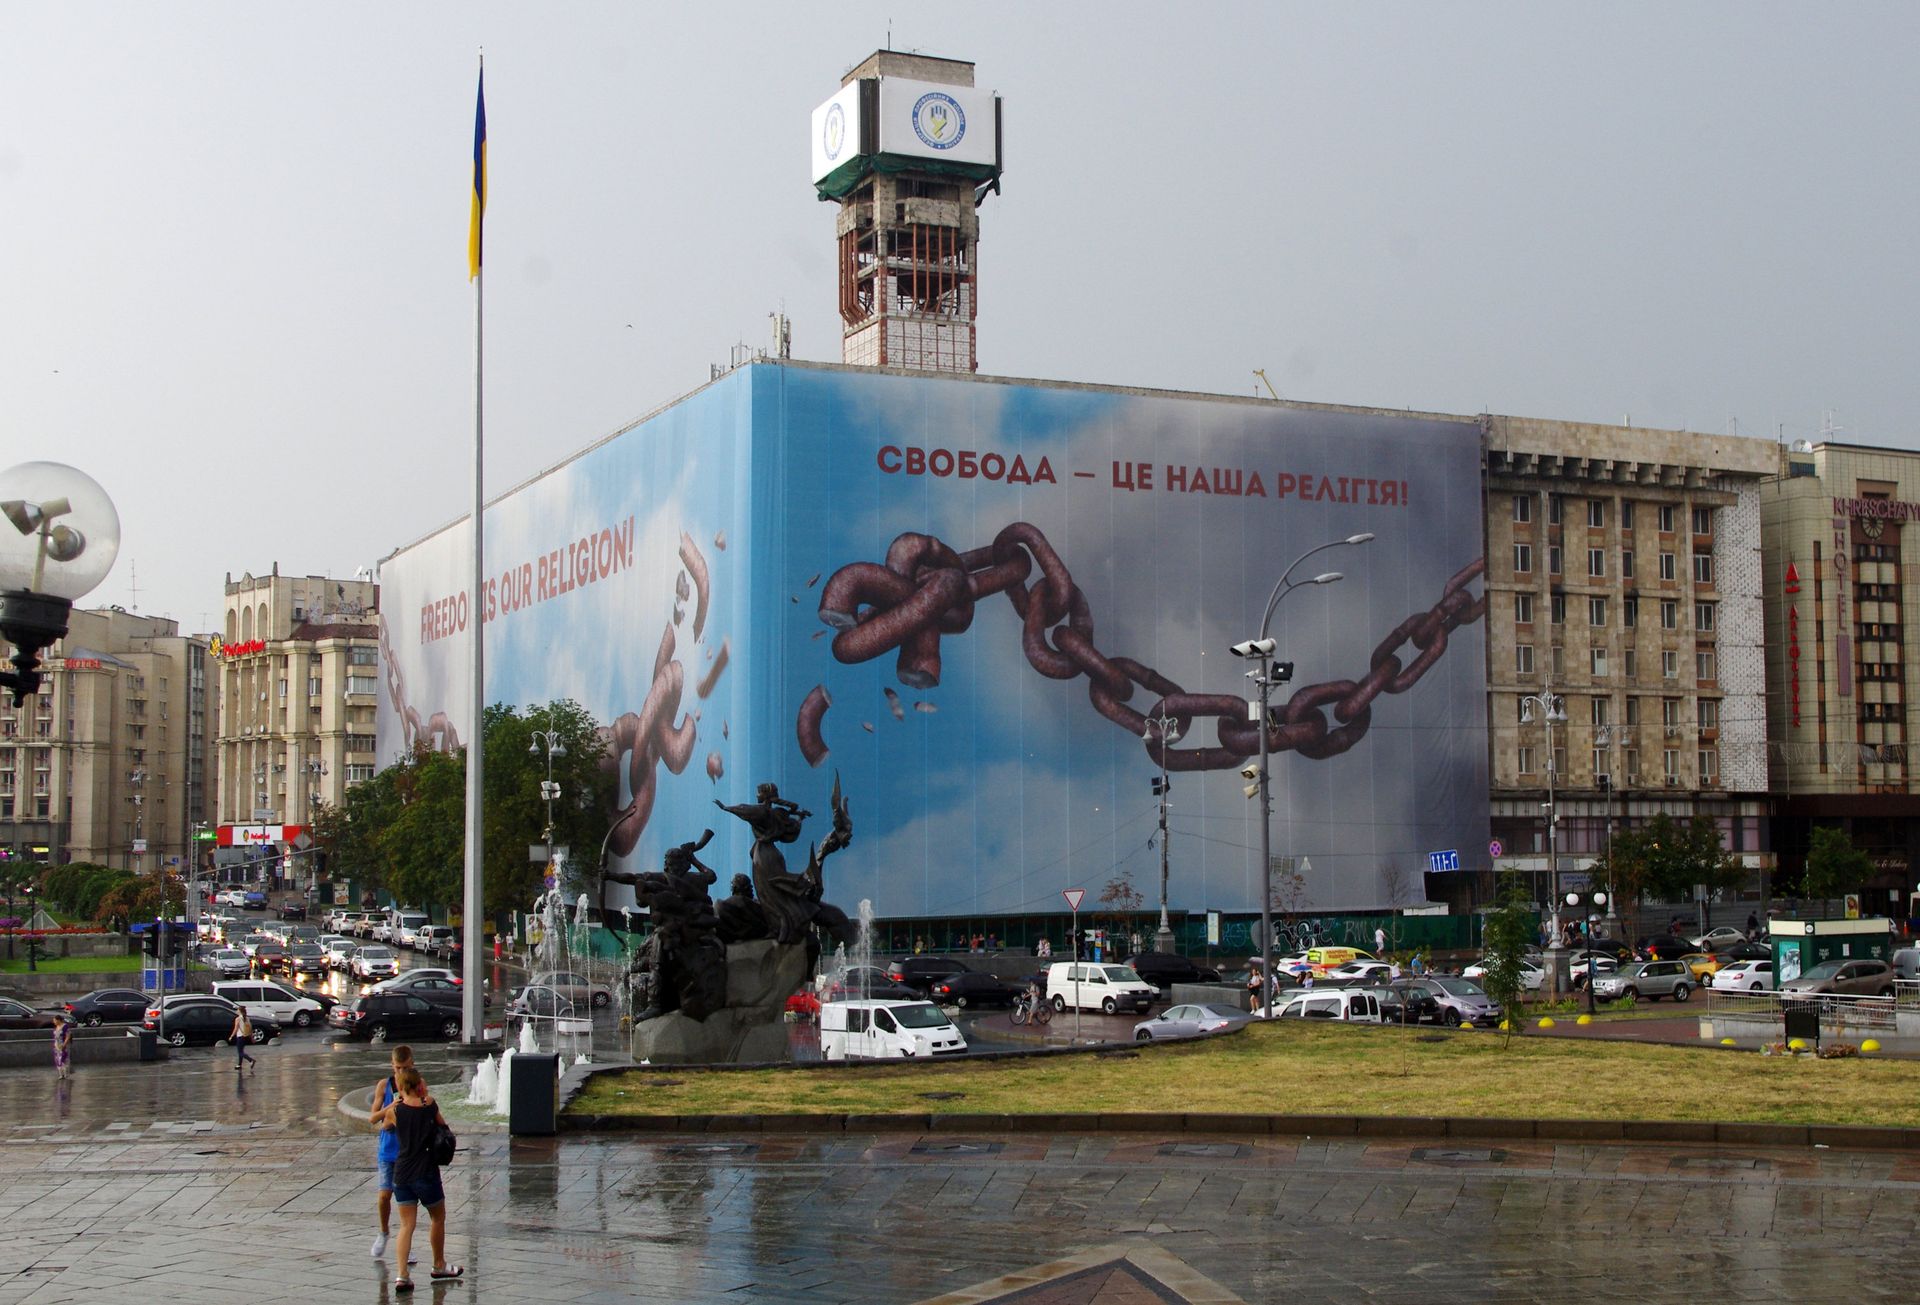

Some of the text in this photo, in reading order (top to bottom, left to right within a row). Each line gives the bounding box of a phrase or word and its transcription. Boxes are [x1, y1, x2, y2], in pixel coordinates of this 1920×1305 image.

[877, 444, 1057, 485] СВОБОДА
[1111, 460, 1153, 492] ЦЕ
[1167, 465, 1267, 498] НАША
[1278, 472, 1409, 506] РЕЛІГІЯ!
[421, 515, 635, 645] FREEDO IS OUR RELIGION!
[1834, 532, 1847, 631] HOTEL
